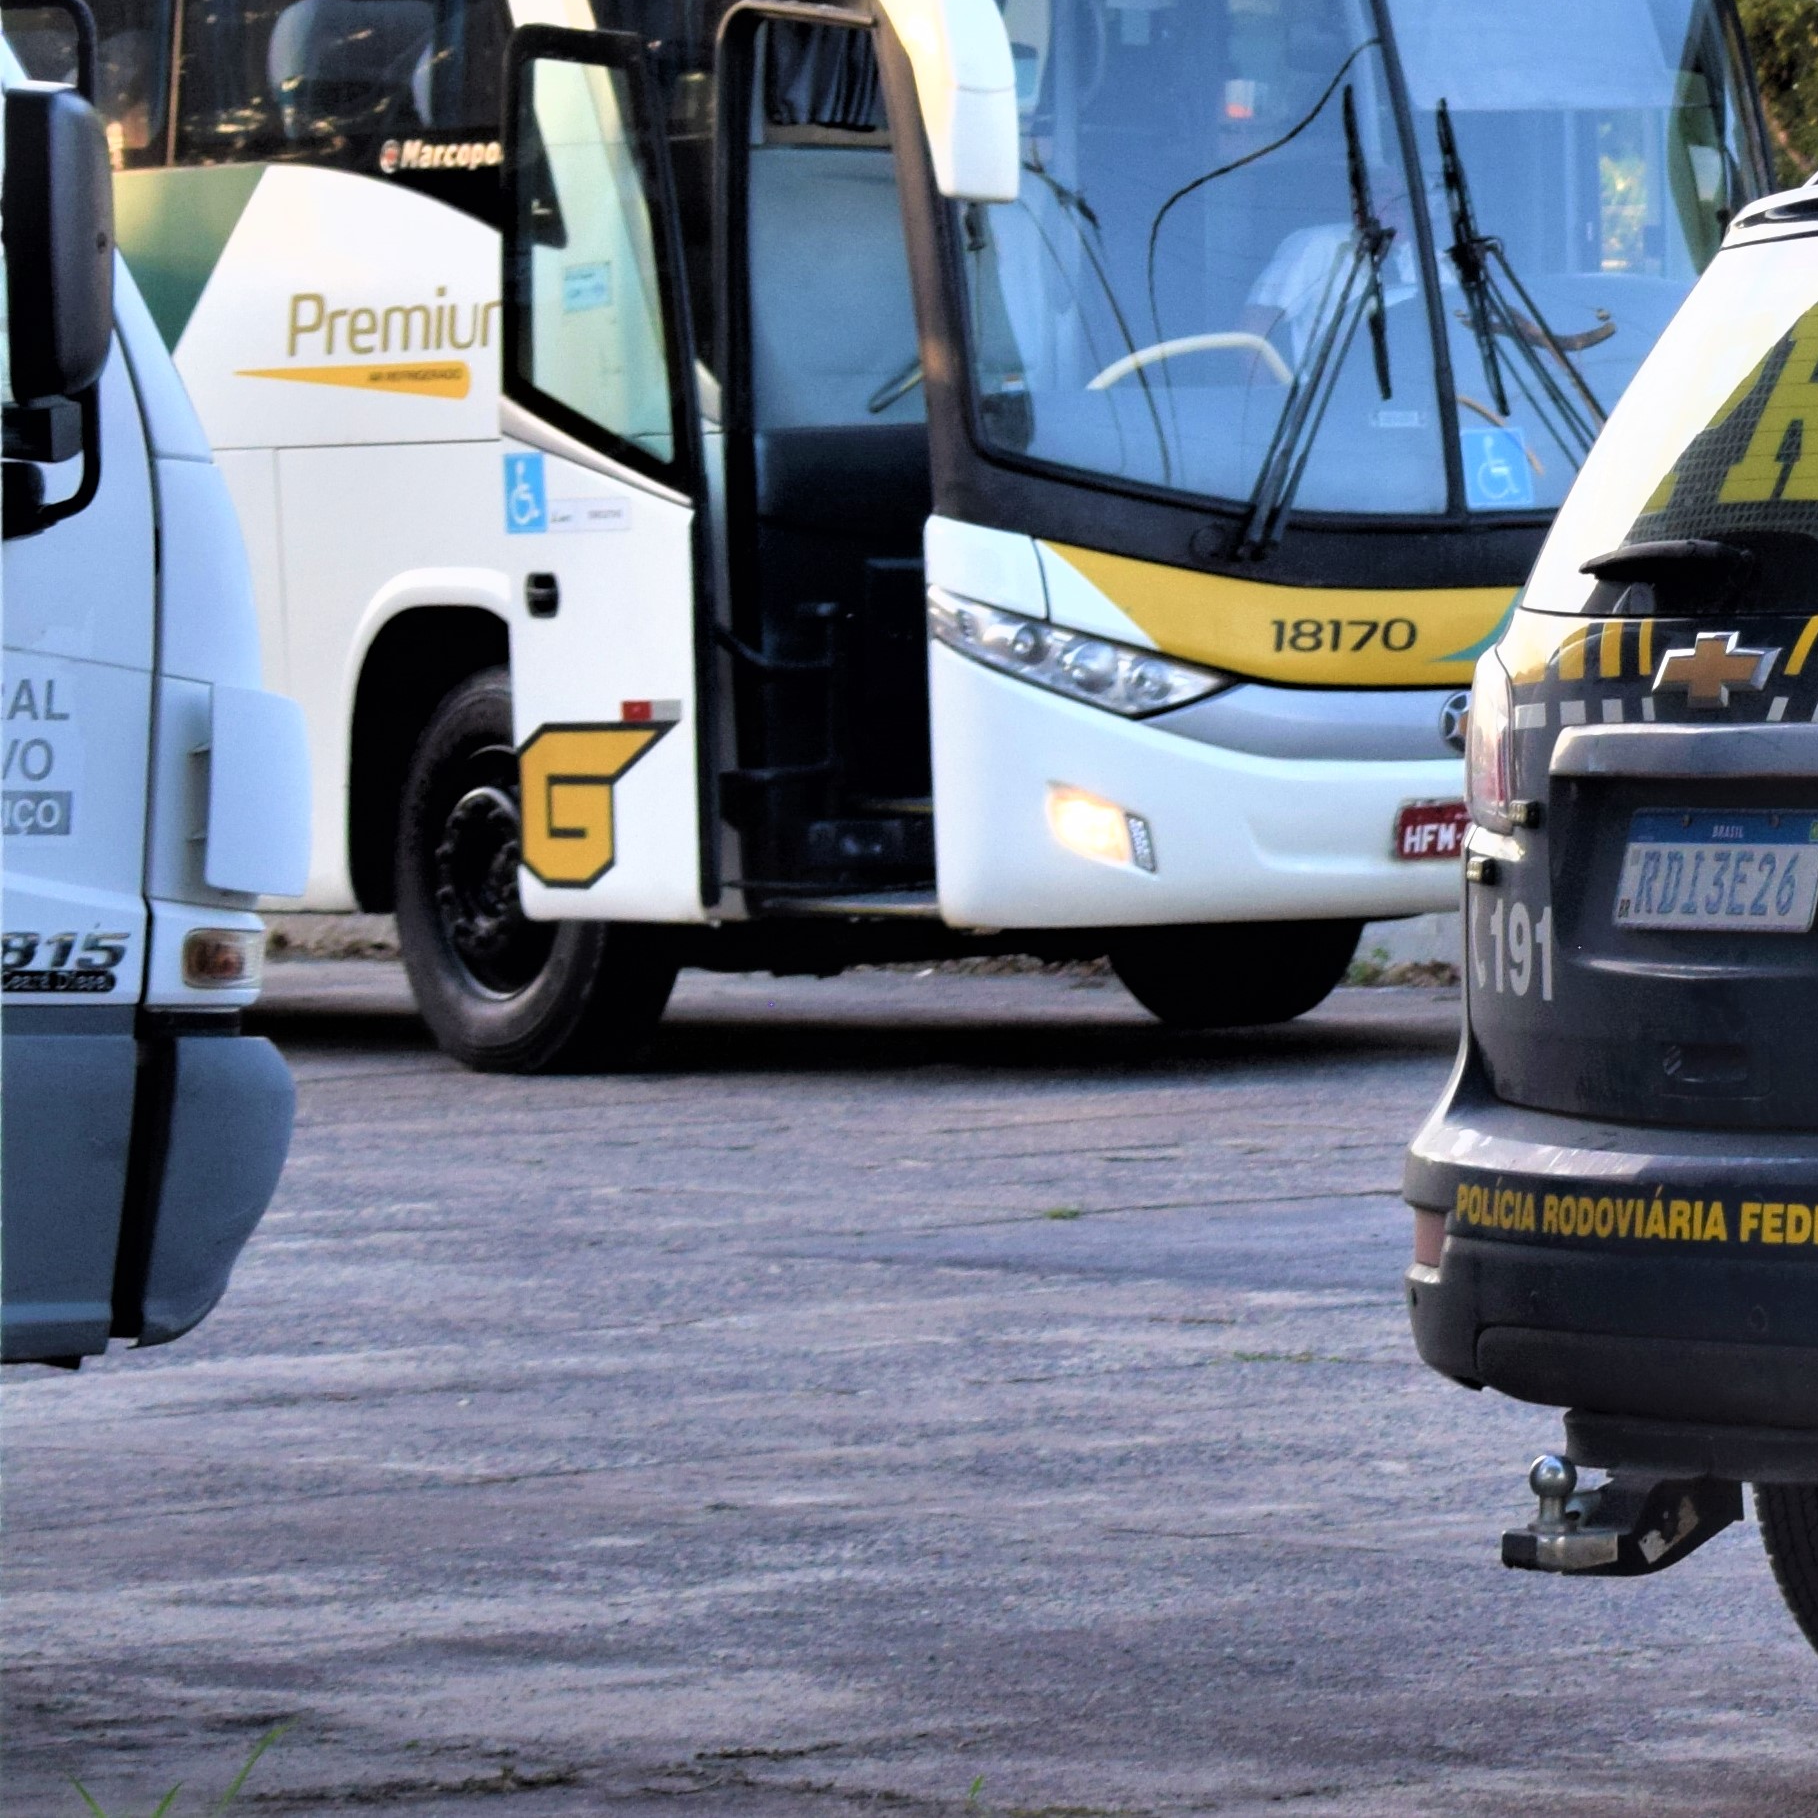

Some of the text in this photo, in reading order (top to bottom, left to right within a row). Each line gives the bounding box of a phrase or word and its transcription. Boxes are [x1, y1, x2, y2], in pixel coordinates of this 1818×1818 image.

[400, 139, 503, 170] Marcopo
[1272, 618, 1418, 652] 18170
[2, 679, 70, 721] AL
[1403, 822, 1464, 855] HFM-
[1712, 825, 1744, 839] BRASIL
[2, 931, 130, 968] 815
[1490, 898, 1553, 1001] 191
[1455, 1177, 1535, 1232] POLÍCIA
[1543, 1185, 1728, 1242] RODOVIÁRIA
